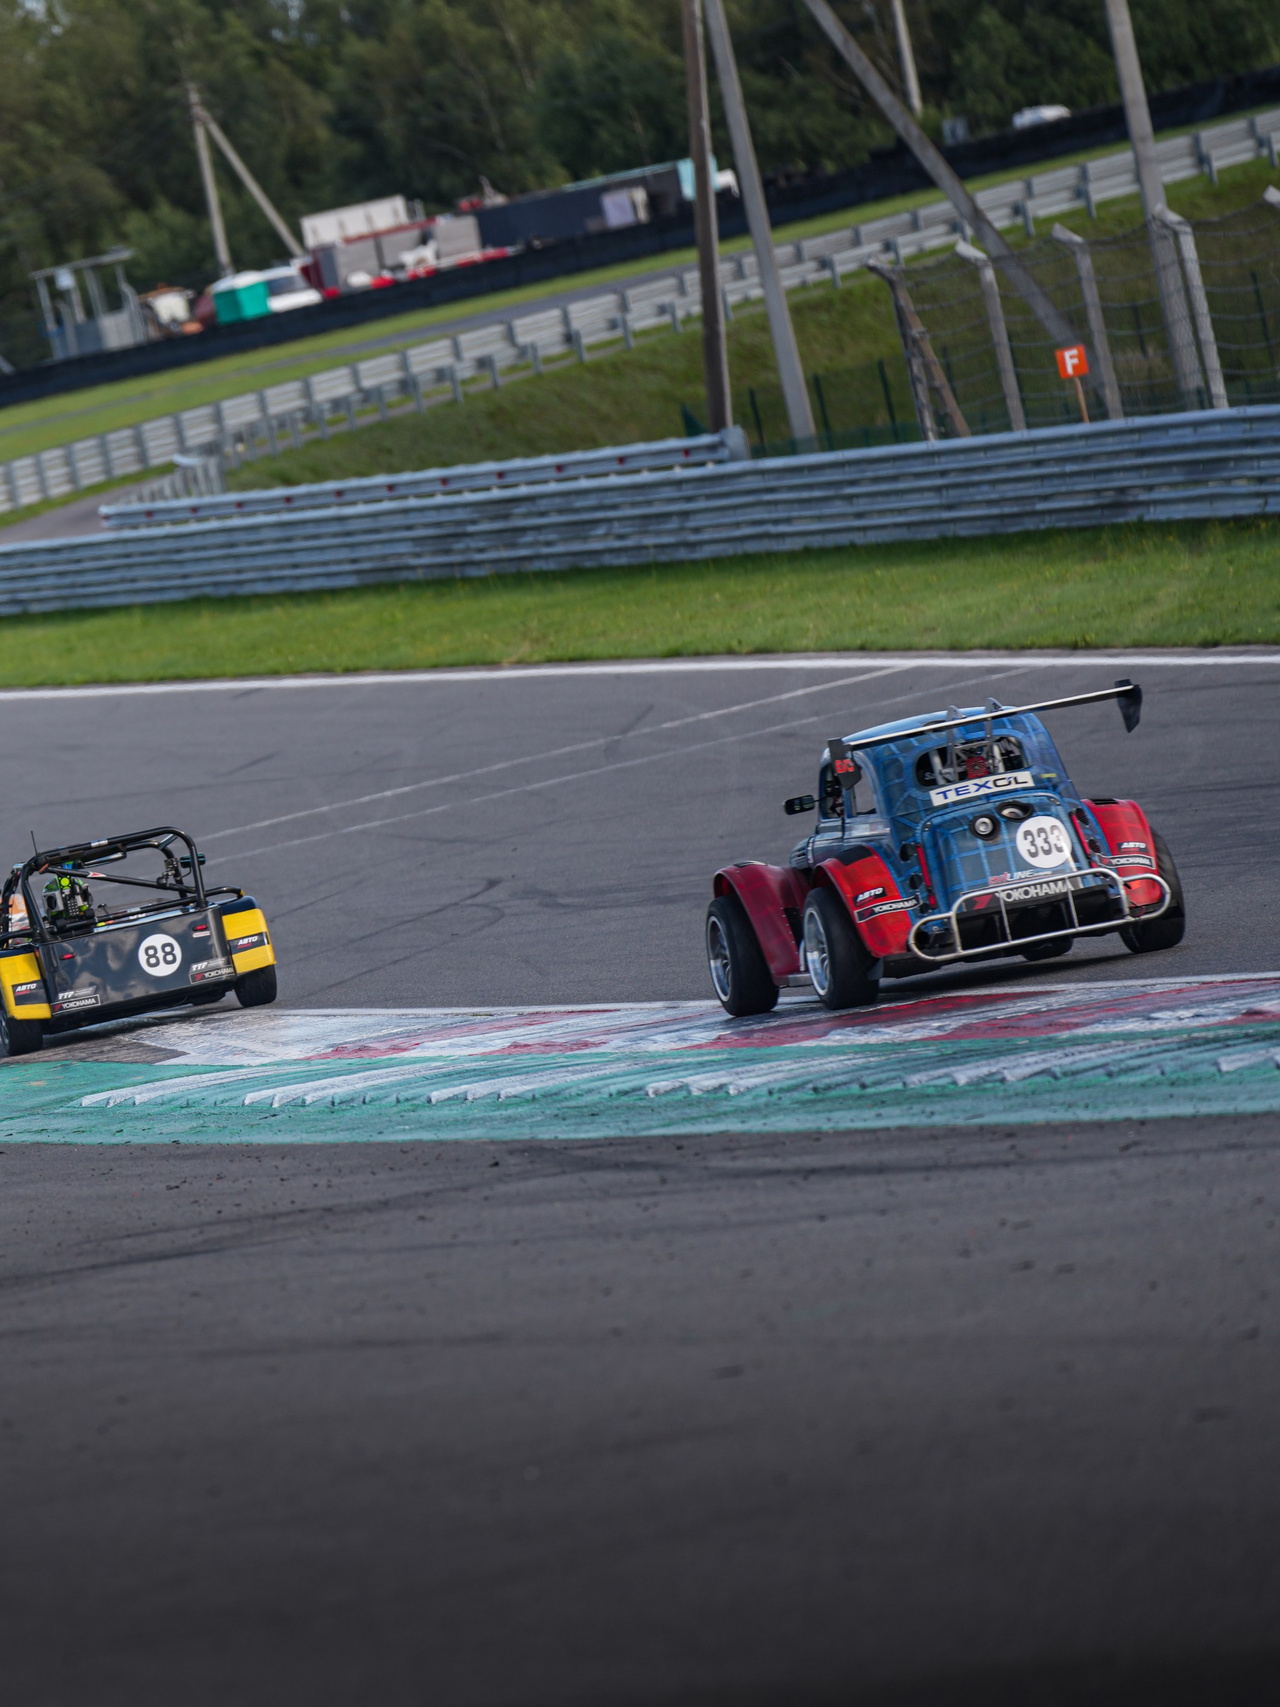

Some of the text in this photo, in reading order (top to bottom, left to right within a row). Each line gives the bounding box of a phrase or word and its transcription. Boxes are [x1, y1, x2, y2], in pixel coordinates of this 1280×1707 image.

[1063, 348, 1079, 375] F
[1023, 824, 1065, 858] 333
[994, 880, 1075, 902] YOKOHAMA
[144, 942, 177, 968] 88
[62, 998, 96, 1009] YOKOHAMA
